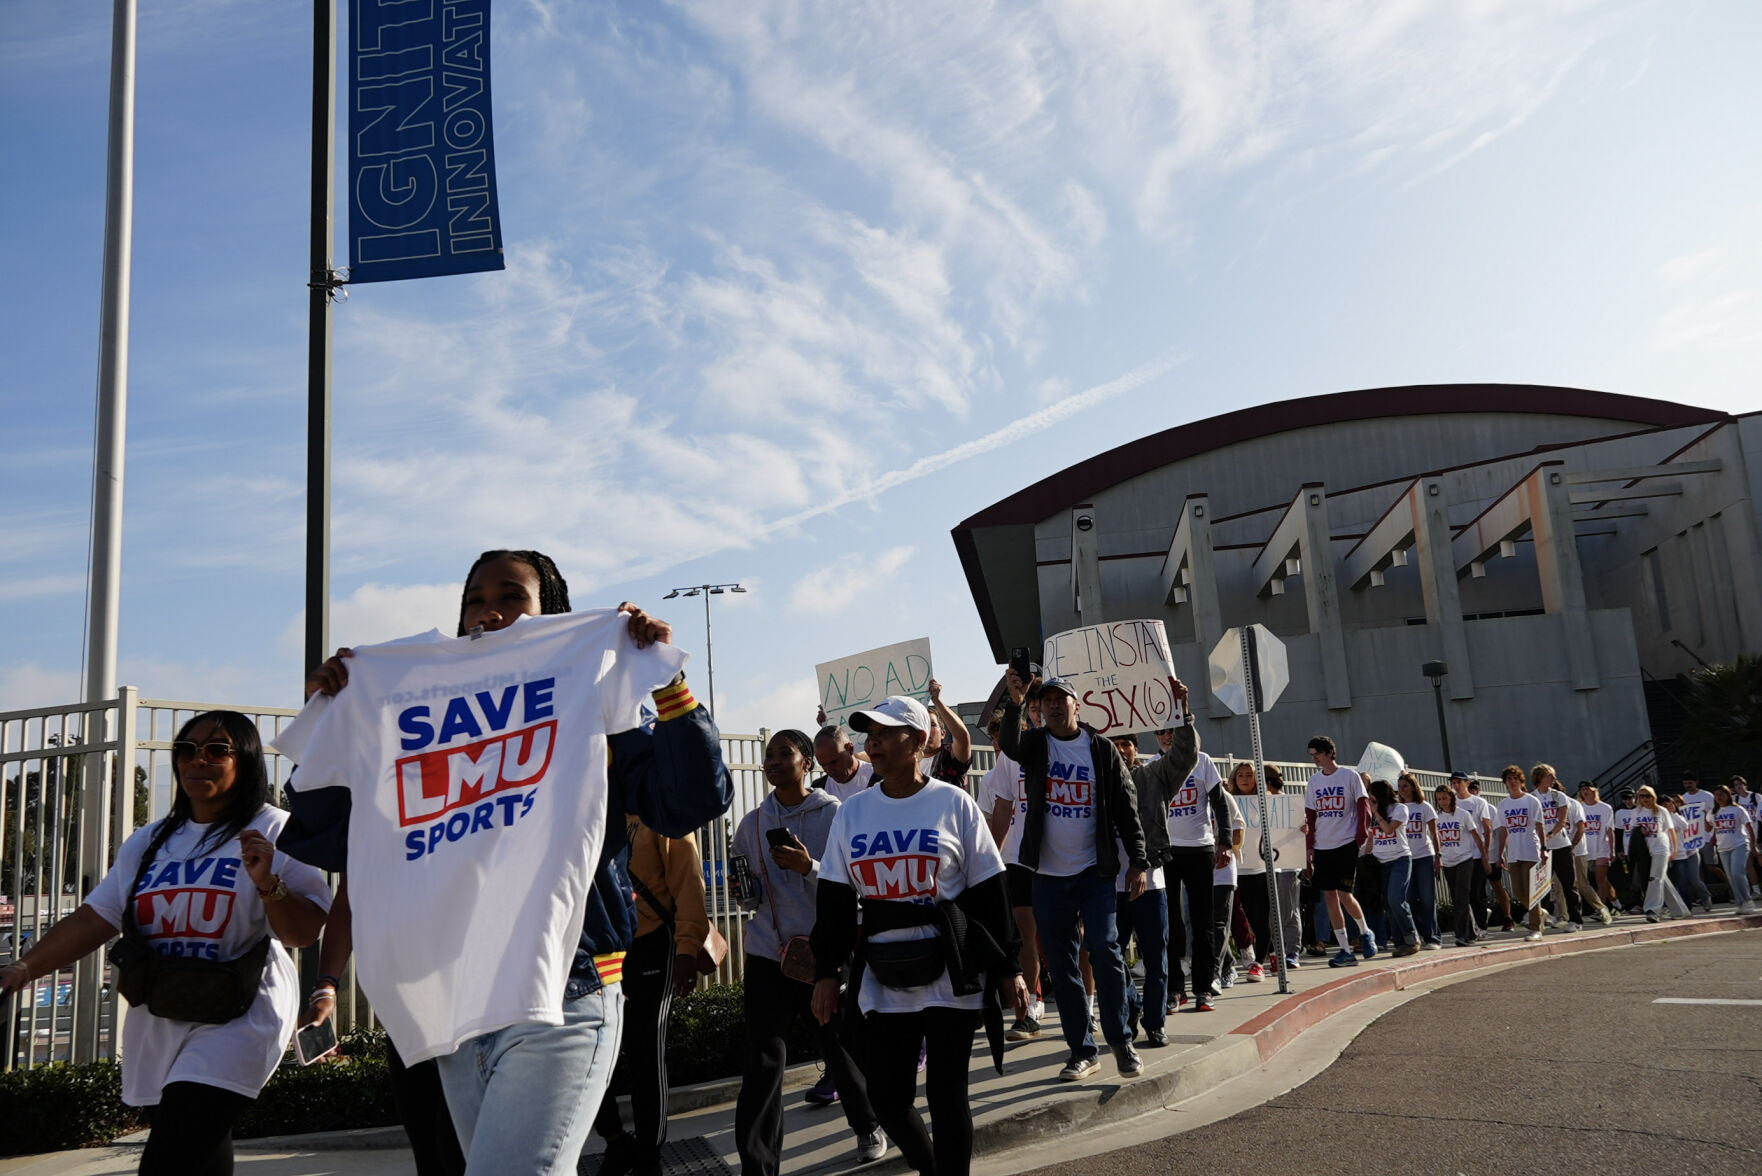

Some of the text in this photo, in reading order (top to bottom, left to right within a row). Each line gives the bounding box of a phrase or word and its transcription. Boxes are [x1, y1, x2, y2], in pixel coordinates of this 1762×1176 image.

[443, 0, 494, 255] INNOVAT
[824, 667, 875, 709] NO
[1095, 674, 1119, 687] THE
[398, 677, 556, 751] SAVE
[401, 725, 551, 820] LMU
[1050, 761, 1089, 781] AVE
[1051, 781, 1089, 803] MU
[1315, 786, 1344, 799] SAVE
[406, 787, 538, 861] SPORTS
[1169, 806, 1197, 818] ORTS
[1318, 810, 1344, 818] PORTS
[1504, 807, 1528, 817] SAVE
[850, 828, 940, 859] SAVE
[852, 857, 937, 897] LMU
